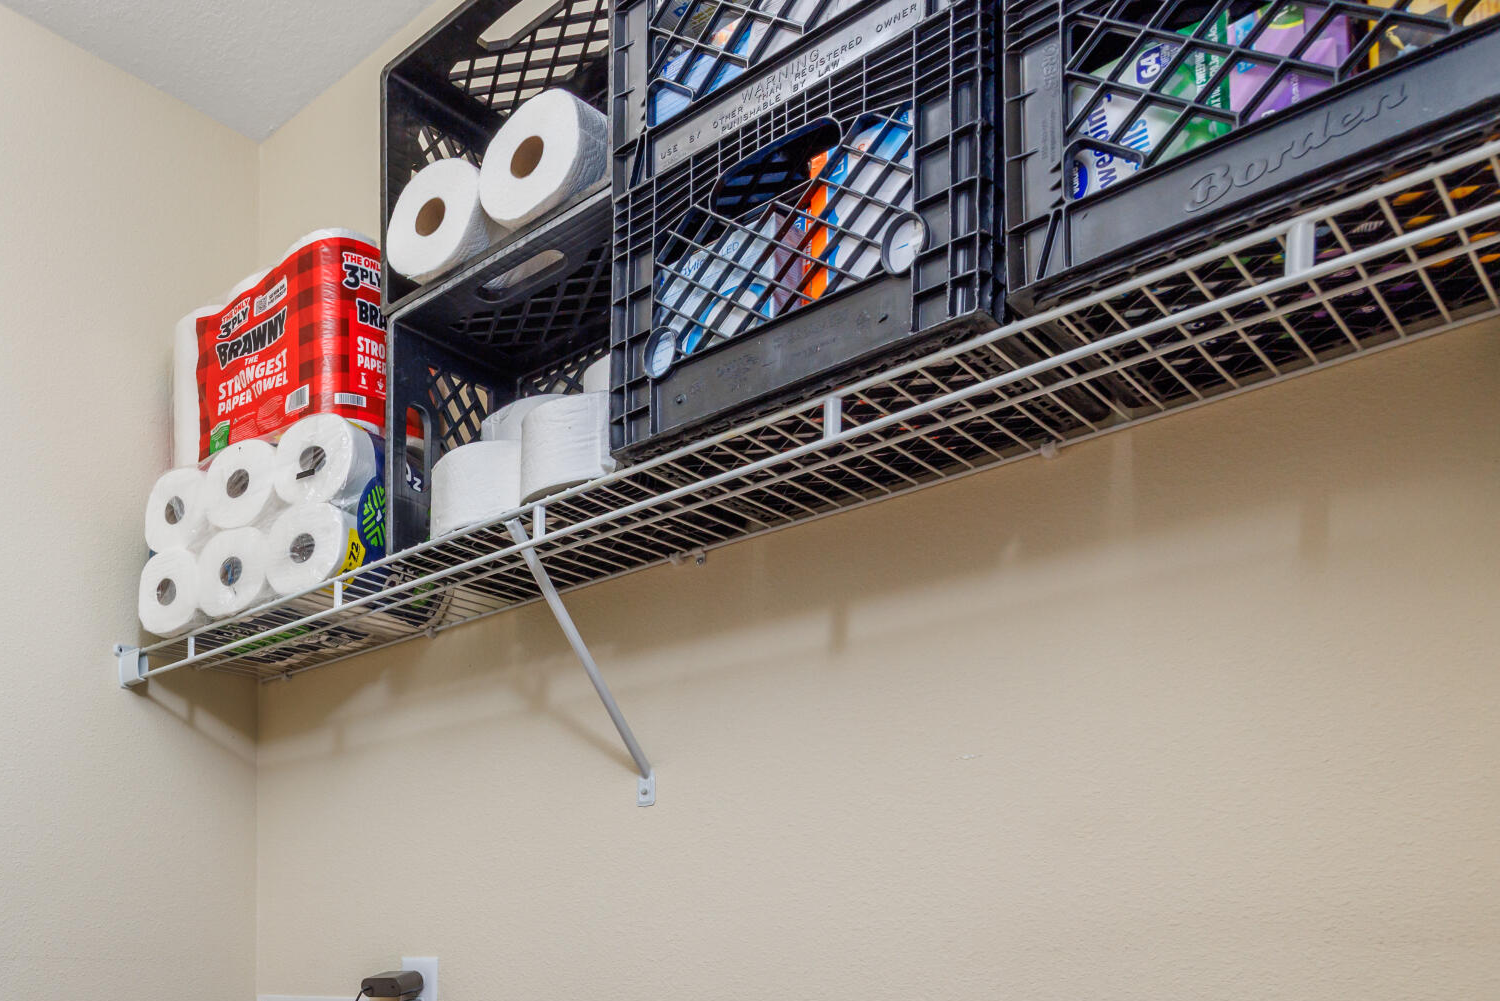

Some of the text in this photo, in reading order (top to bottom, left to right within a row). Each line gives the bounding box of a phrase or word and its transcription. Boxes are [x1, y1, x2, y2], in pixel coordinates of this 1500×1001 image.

[660, 144, 678, 160] USE
[713, 106, 743, 128] OTHER
[756, 83, 782, 102] THAN
[794, 35, 863, 81] REGISTERED
[875, 3, 918, 33] OWNER
[741, 48, 820, 103] WARNING
[1141, 52, 1160, 78] 64
[721, 57, 839, 132] PUNISHABLE BY LAW
[1184, 83, 1408, 212] Borden
[343, 252, 380, 271] THE ONL
[223, 297, 250, 323] THE ONLY
[356, 299, 387, 331] BRA
[216, 306, 287, 369] BRAWNY
[245, 354, 259, 366] THE
[357, 335, 386, 359] STRO
[217, 371, 288, 416] PAPER TOWEL
[218, 348, 287, 400] STRONGEST
